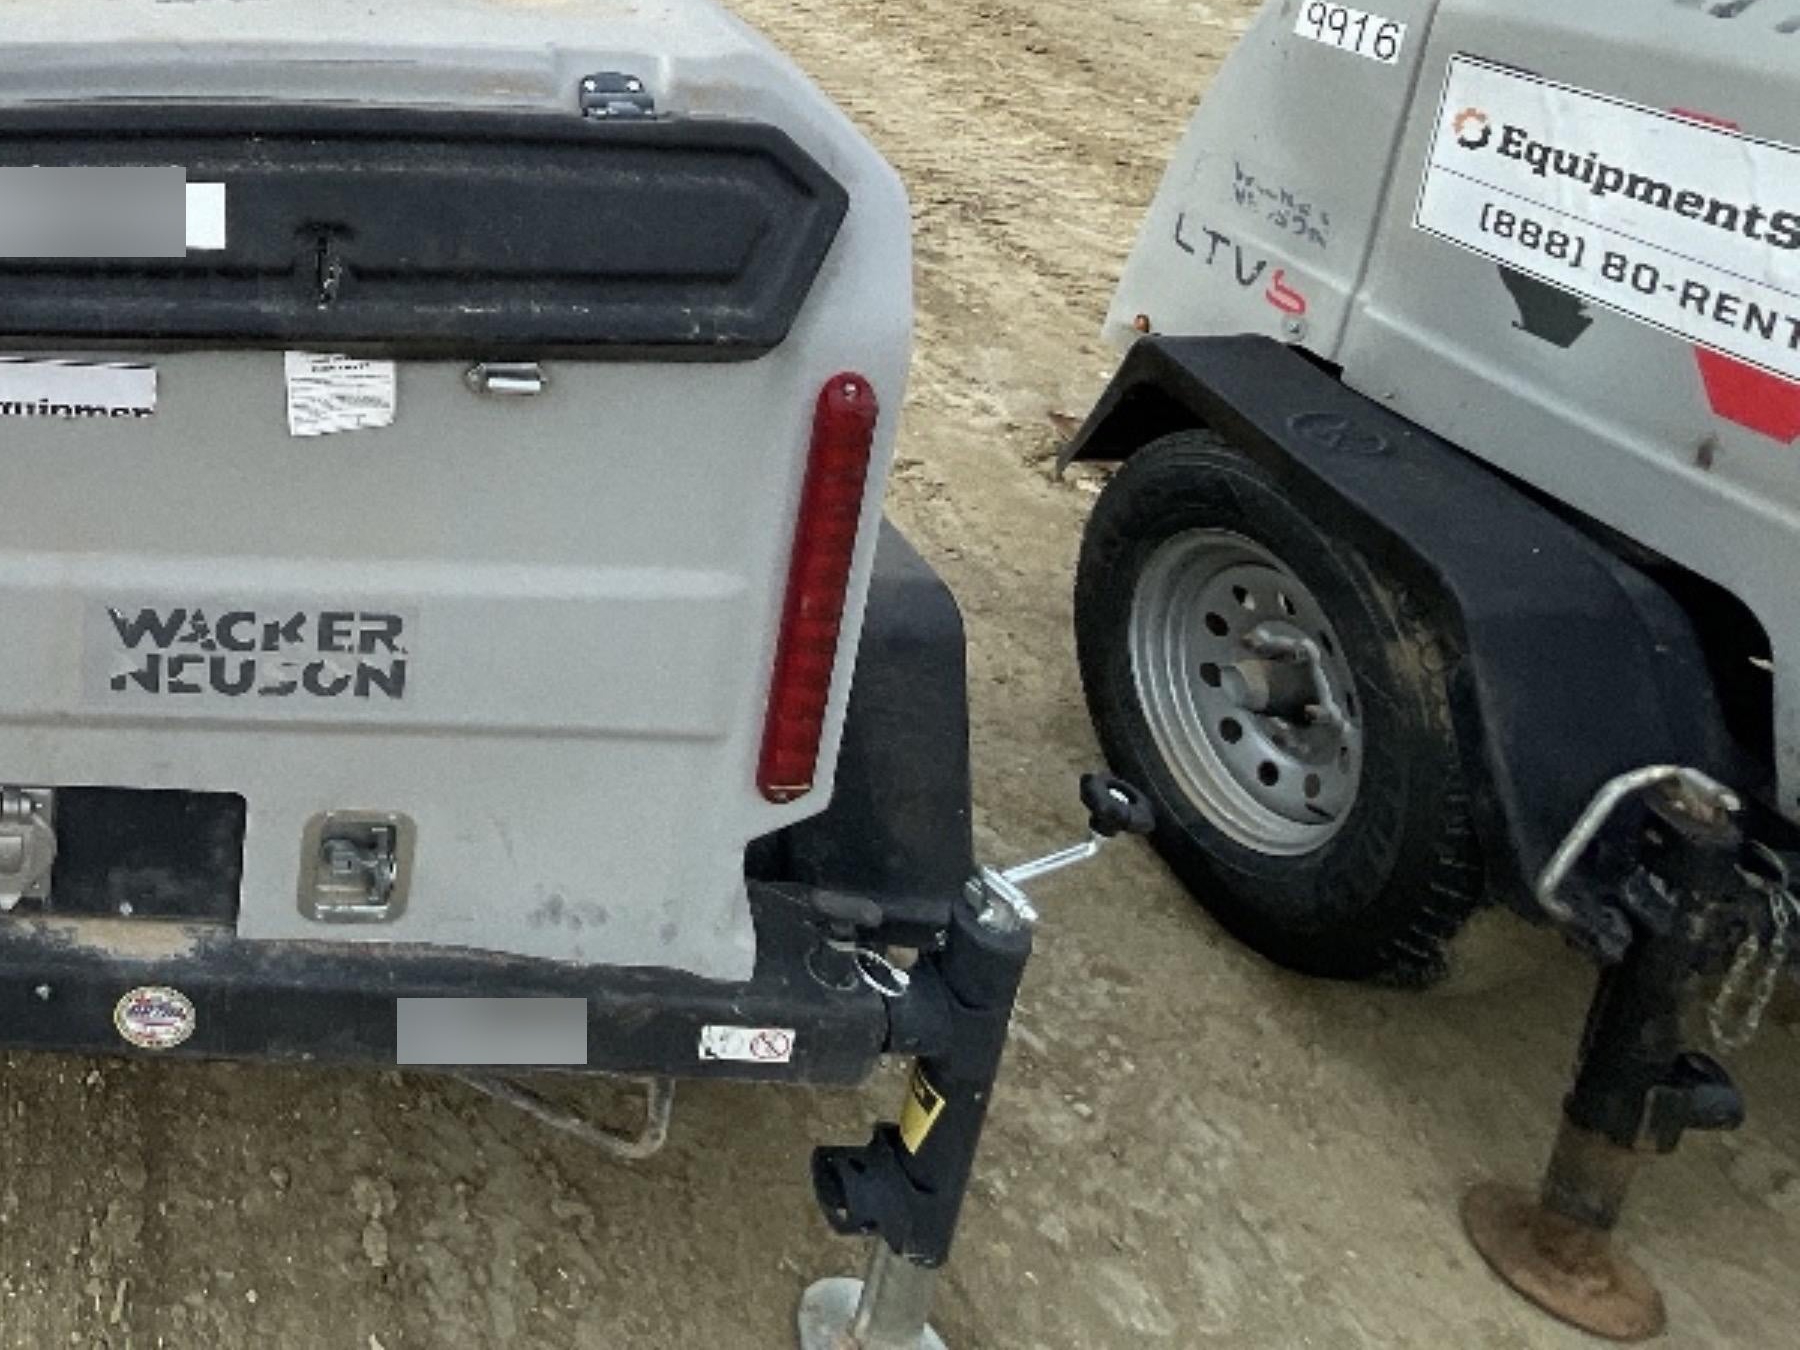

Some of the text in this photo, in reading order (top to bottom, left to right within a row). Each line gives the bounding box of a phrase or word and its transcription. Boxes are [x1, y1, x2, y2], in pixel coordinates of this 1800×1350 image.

[1307, 2, 1398, 60] 9916
[1480, 203, 1586, 268] (888)
[105, 607, 409, 654] WACKER
